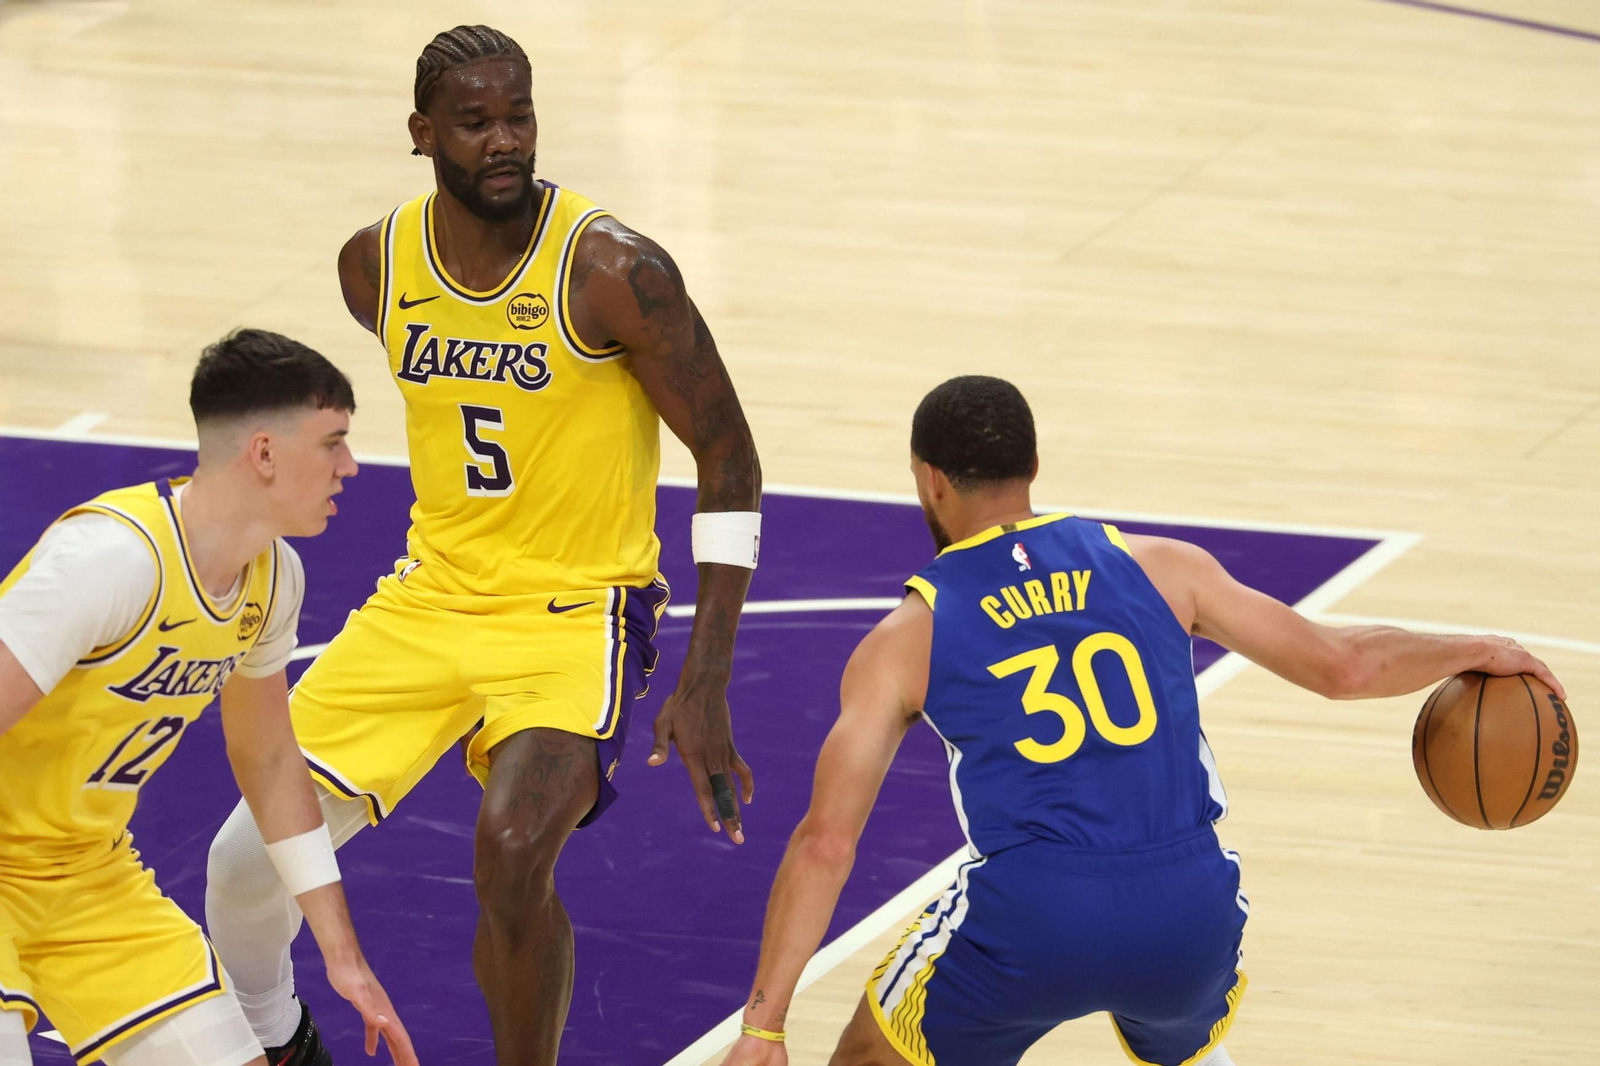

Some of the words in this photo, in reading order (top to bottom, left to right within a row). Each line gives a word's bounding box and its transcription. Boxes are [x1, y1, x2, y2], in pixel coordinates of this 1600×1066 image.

[511, 303, 546, 319] bibigo
[397, 322, 553, 392] LAKERS
[458, 403, 516, 498] 5
[980, 570, 1091, 629] CURRY
[986, 631, 1158, 763] 30
[83, 715, 186, 791] 12
[1537, 693, 1571, 801] Wilson
